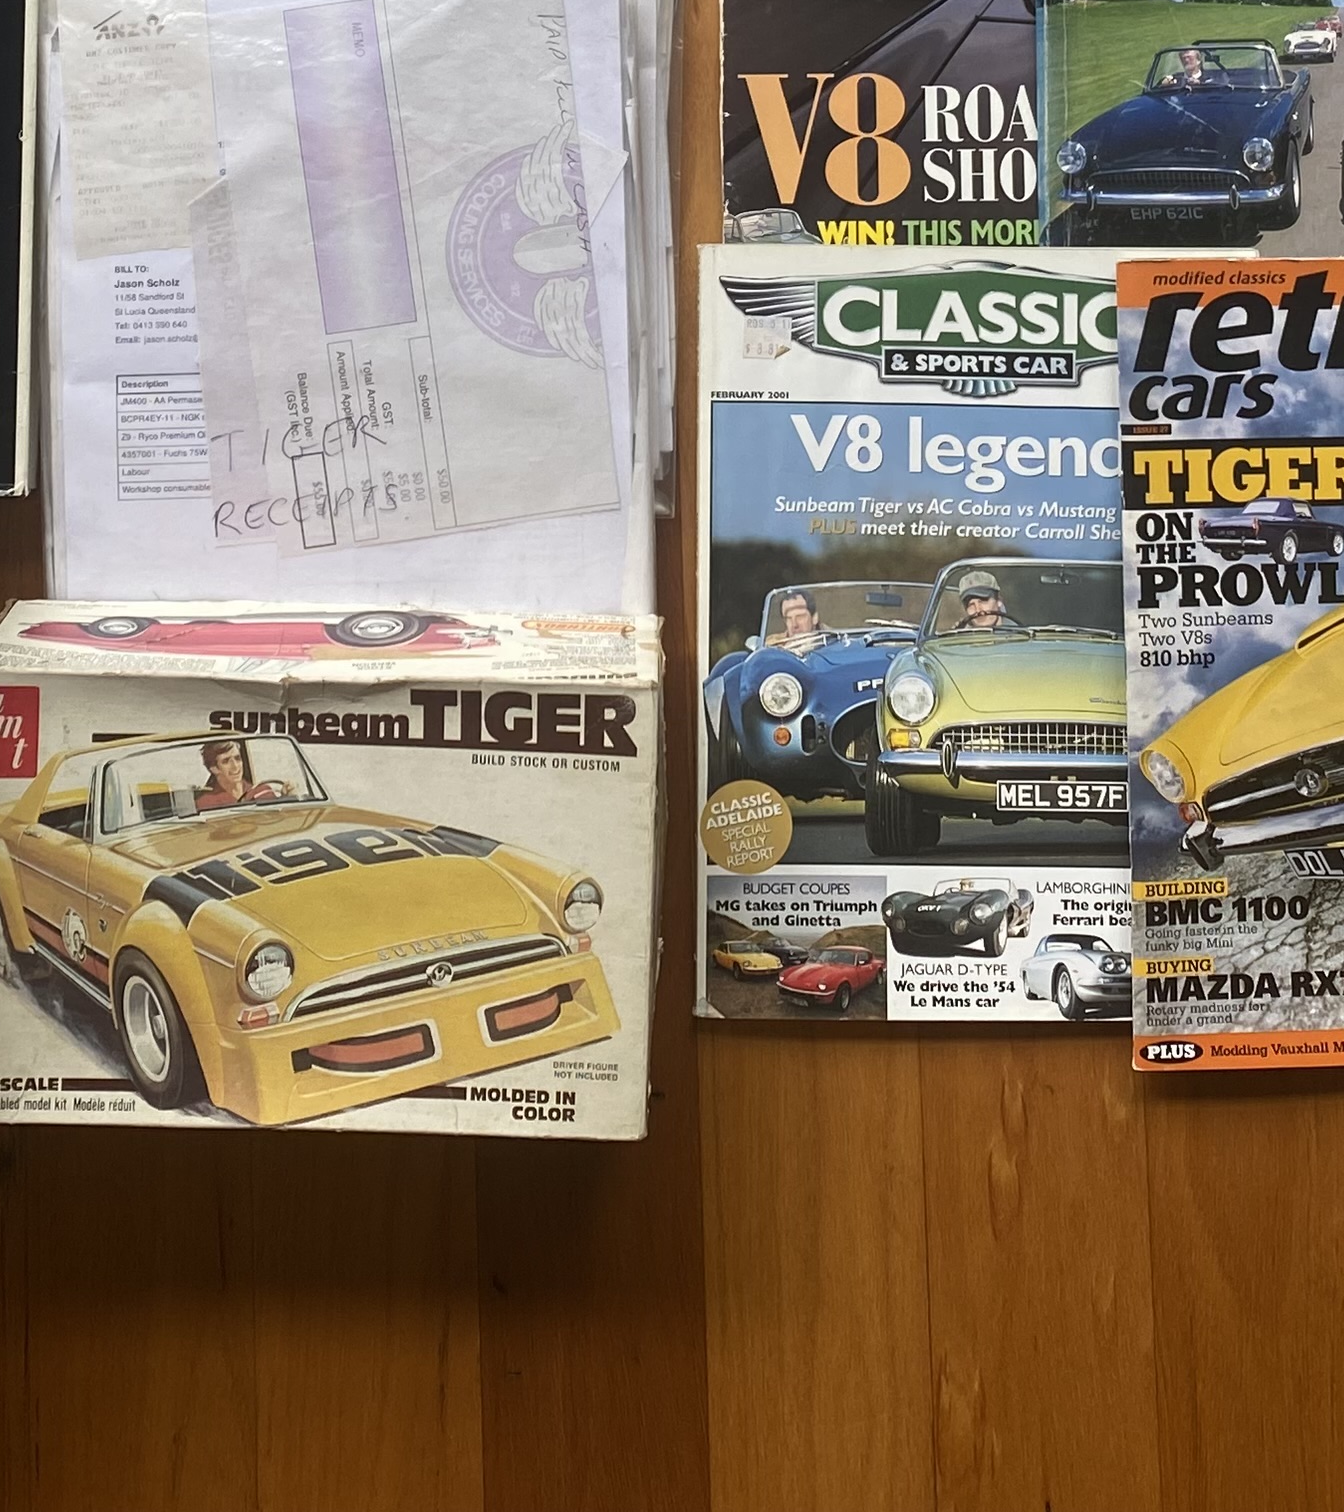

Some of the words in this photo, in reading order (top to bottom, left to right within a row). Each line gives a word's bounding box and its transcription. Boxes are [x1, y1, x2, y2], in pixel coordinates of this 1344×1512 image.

[738, 72, 912, 206] V8
[1152, 269, 1223, 287] modified
[1228, 269, 1288, 286] classics
[890, 354, 909, 373] &
[914, 353, 1007, 374] SPORTS
[1012, 354, 1067, 375] CAR
[711, 391, 764, 400] FEBRUARY
[766, 391, 789, 400] 2001
[1128, 372, 1277, 423] cars
[775, 495, 855, 514] Sunbeam
[858, 498, 902, 518] Tiger
[905, 503, 925, 515] vs
[926, 498, 953, 516] AC
[958, 499, 1012, 517] Cobra
[1017, 505, 1035, 518] vs
[1040, 501, 1116, 523] Mustang
[1138, 614, 1177, 629] Two
[1182, 611, 1274, 629] Sunbeams
[411, 690, 637, 757] TIGER
[0, 1077, 60, 1092] SCALE
[23, 1097, 50, 1111] model
[55, 1097, 67, 1112] kit
[73, 1097, 103, 1112] Modèle
[107, 1098, 136, 1112] réduit
